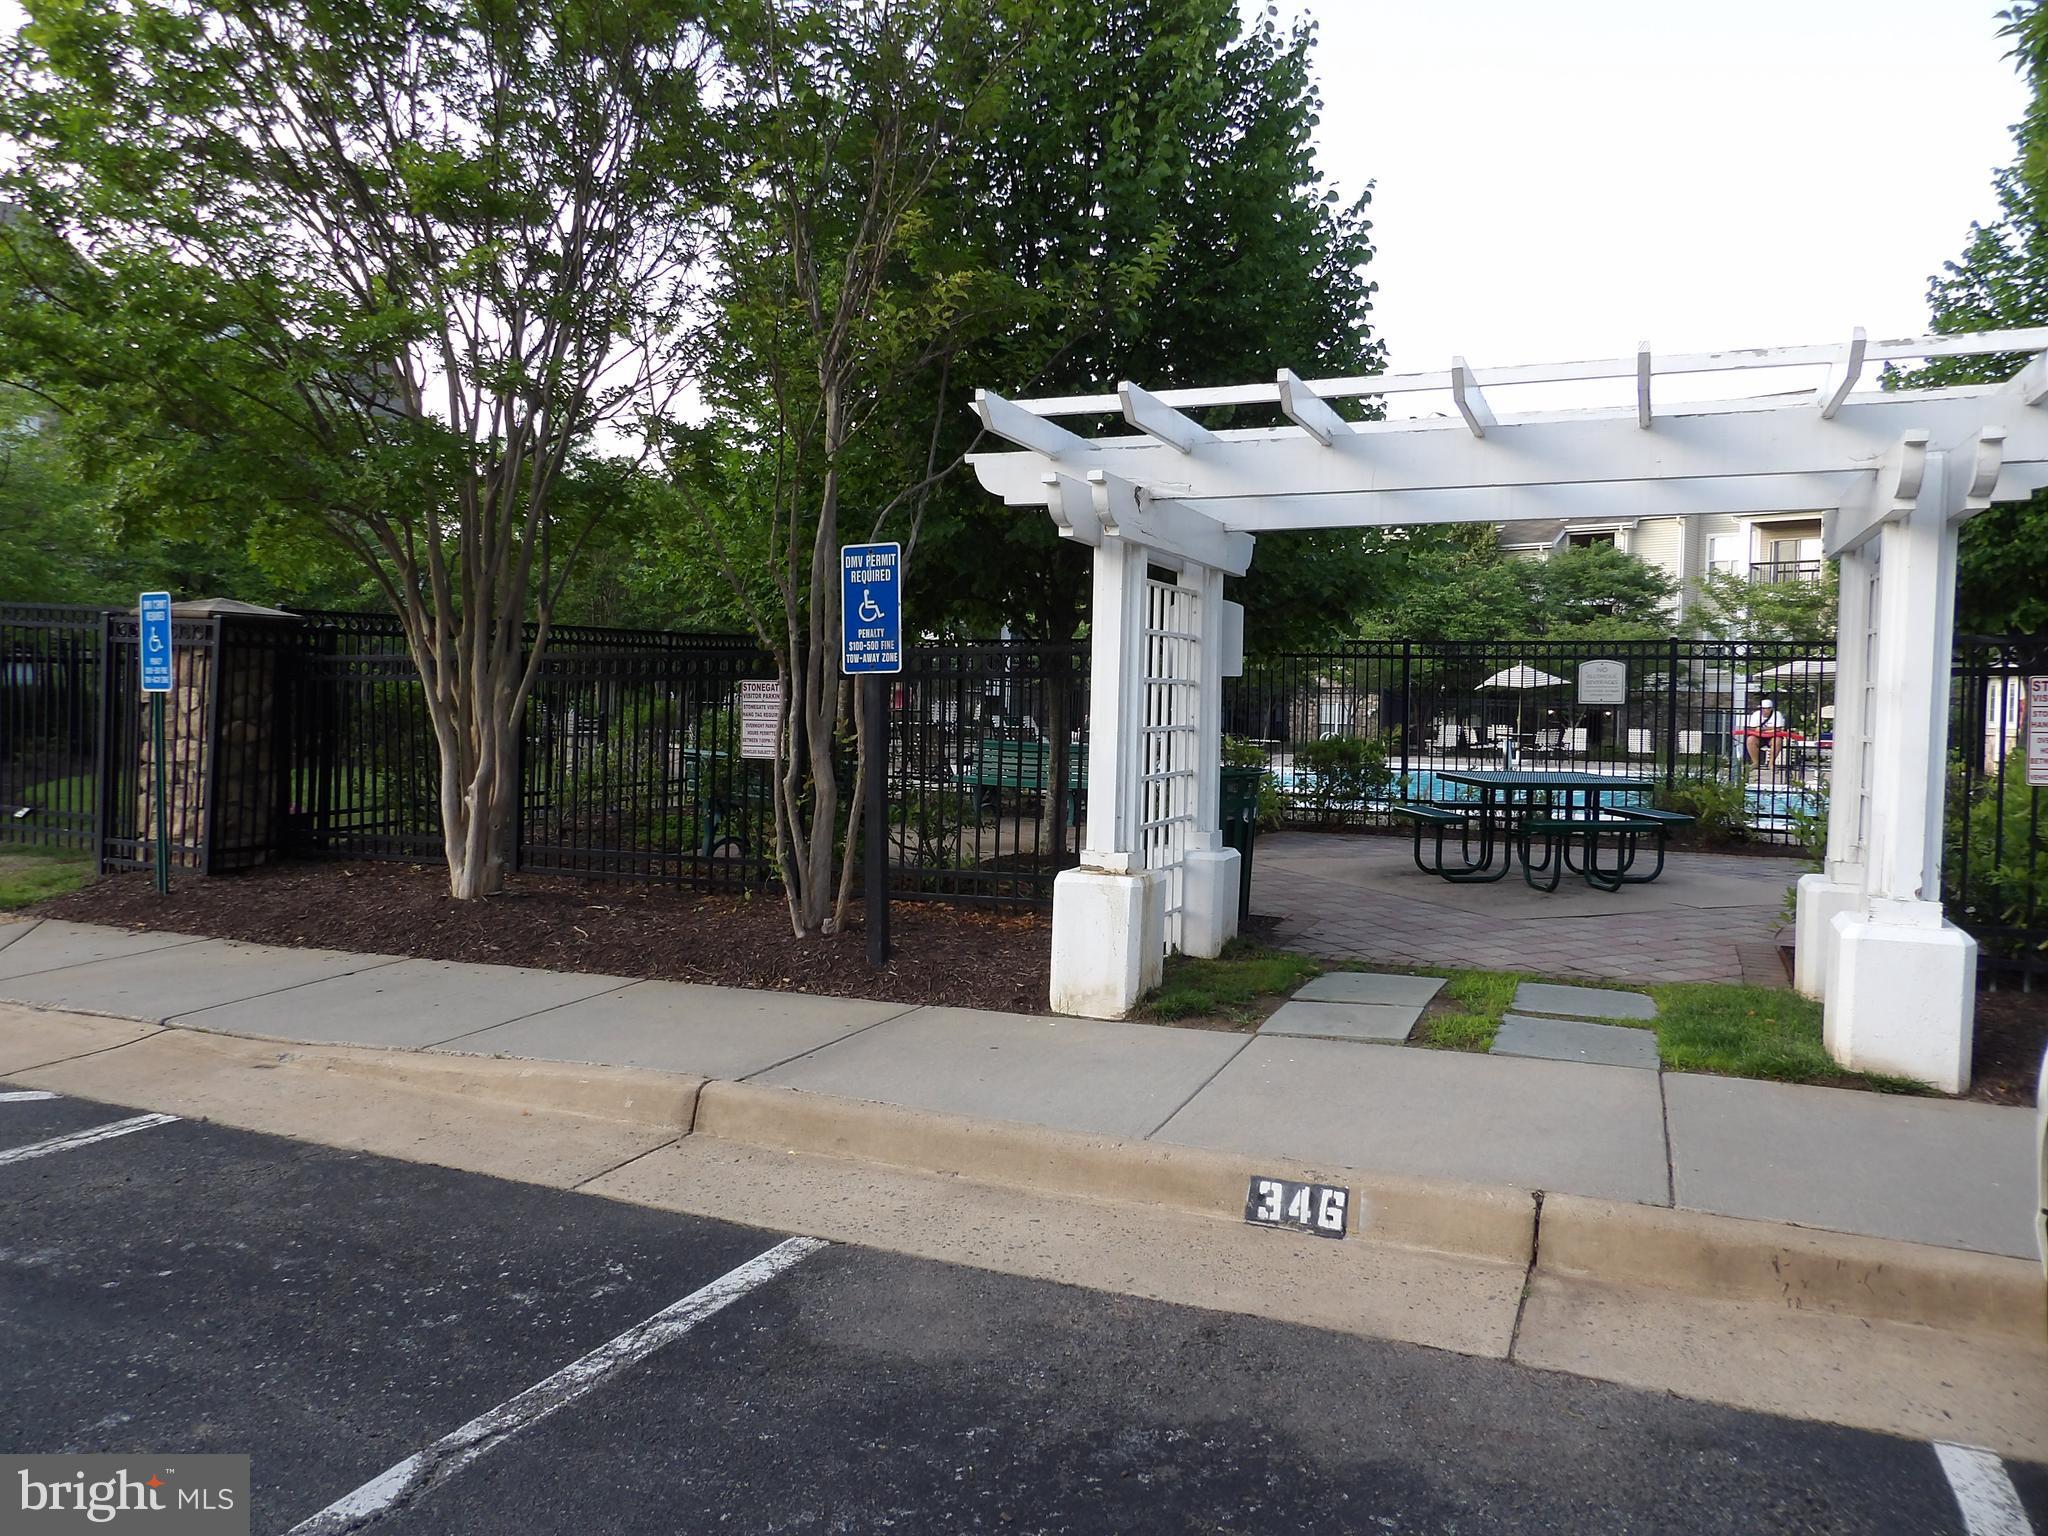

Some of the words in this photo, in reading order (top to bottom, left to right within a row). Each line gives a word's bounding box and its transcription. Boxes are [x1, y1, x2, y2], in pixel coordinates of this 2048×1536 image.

[845, 556, 863, 569] DMV
[866, 553, 897, 568] PERMIT
[851, 569, 891, 584] REQUIRED
[858, 628, 884, 639] PENALTY
[848, 640, 879, 651] $100-500
[881, 640, 895, 650] FINE
[846, 653, 880, 664] TOW-AWAY
[882, 652, 898, 662] ZONE
[742, 683, 779, 692] STONEGAT
